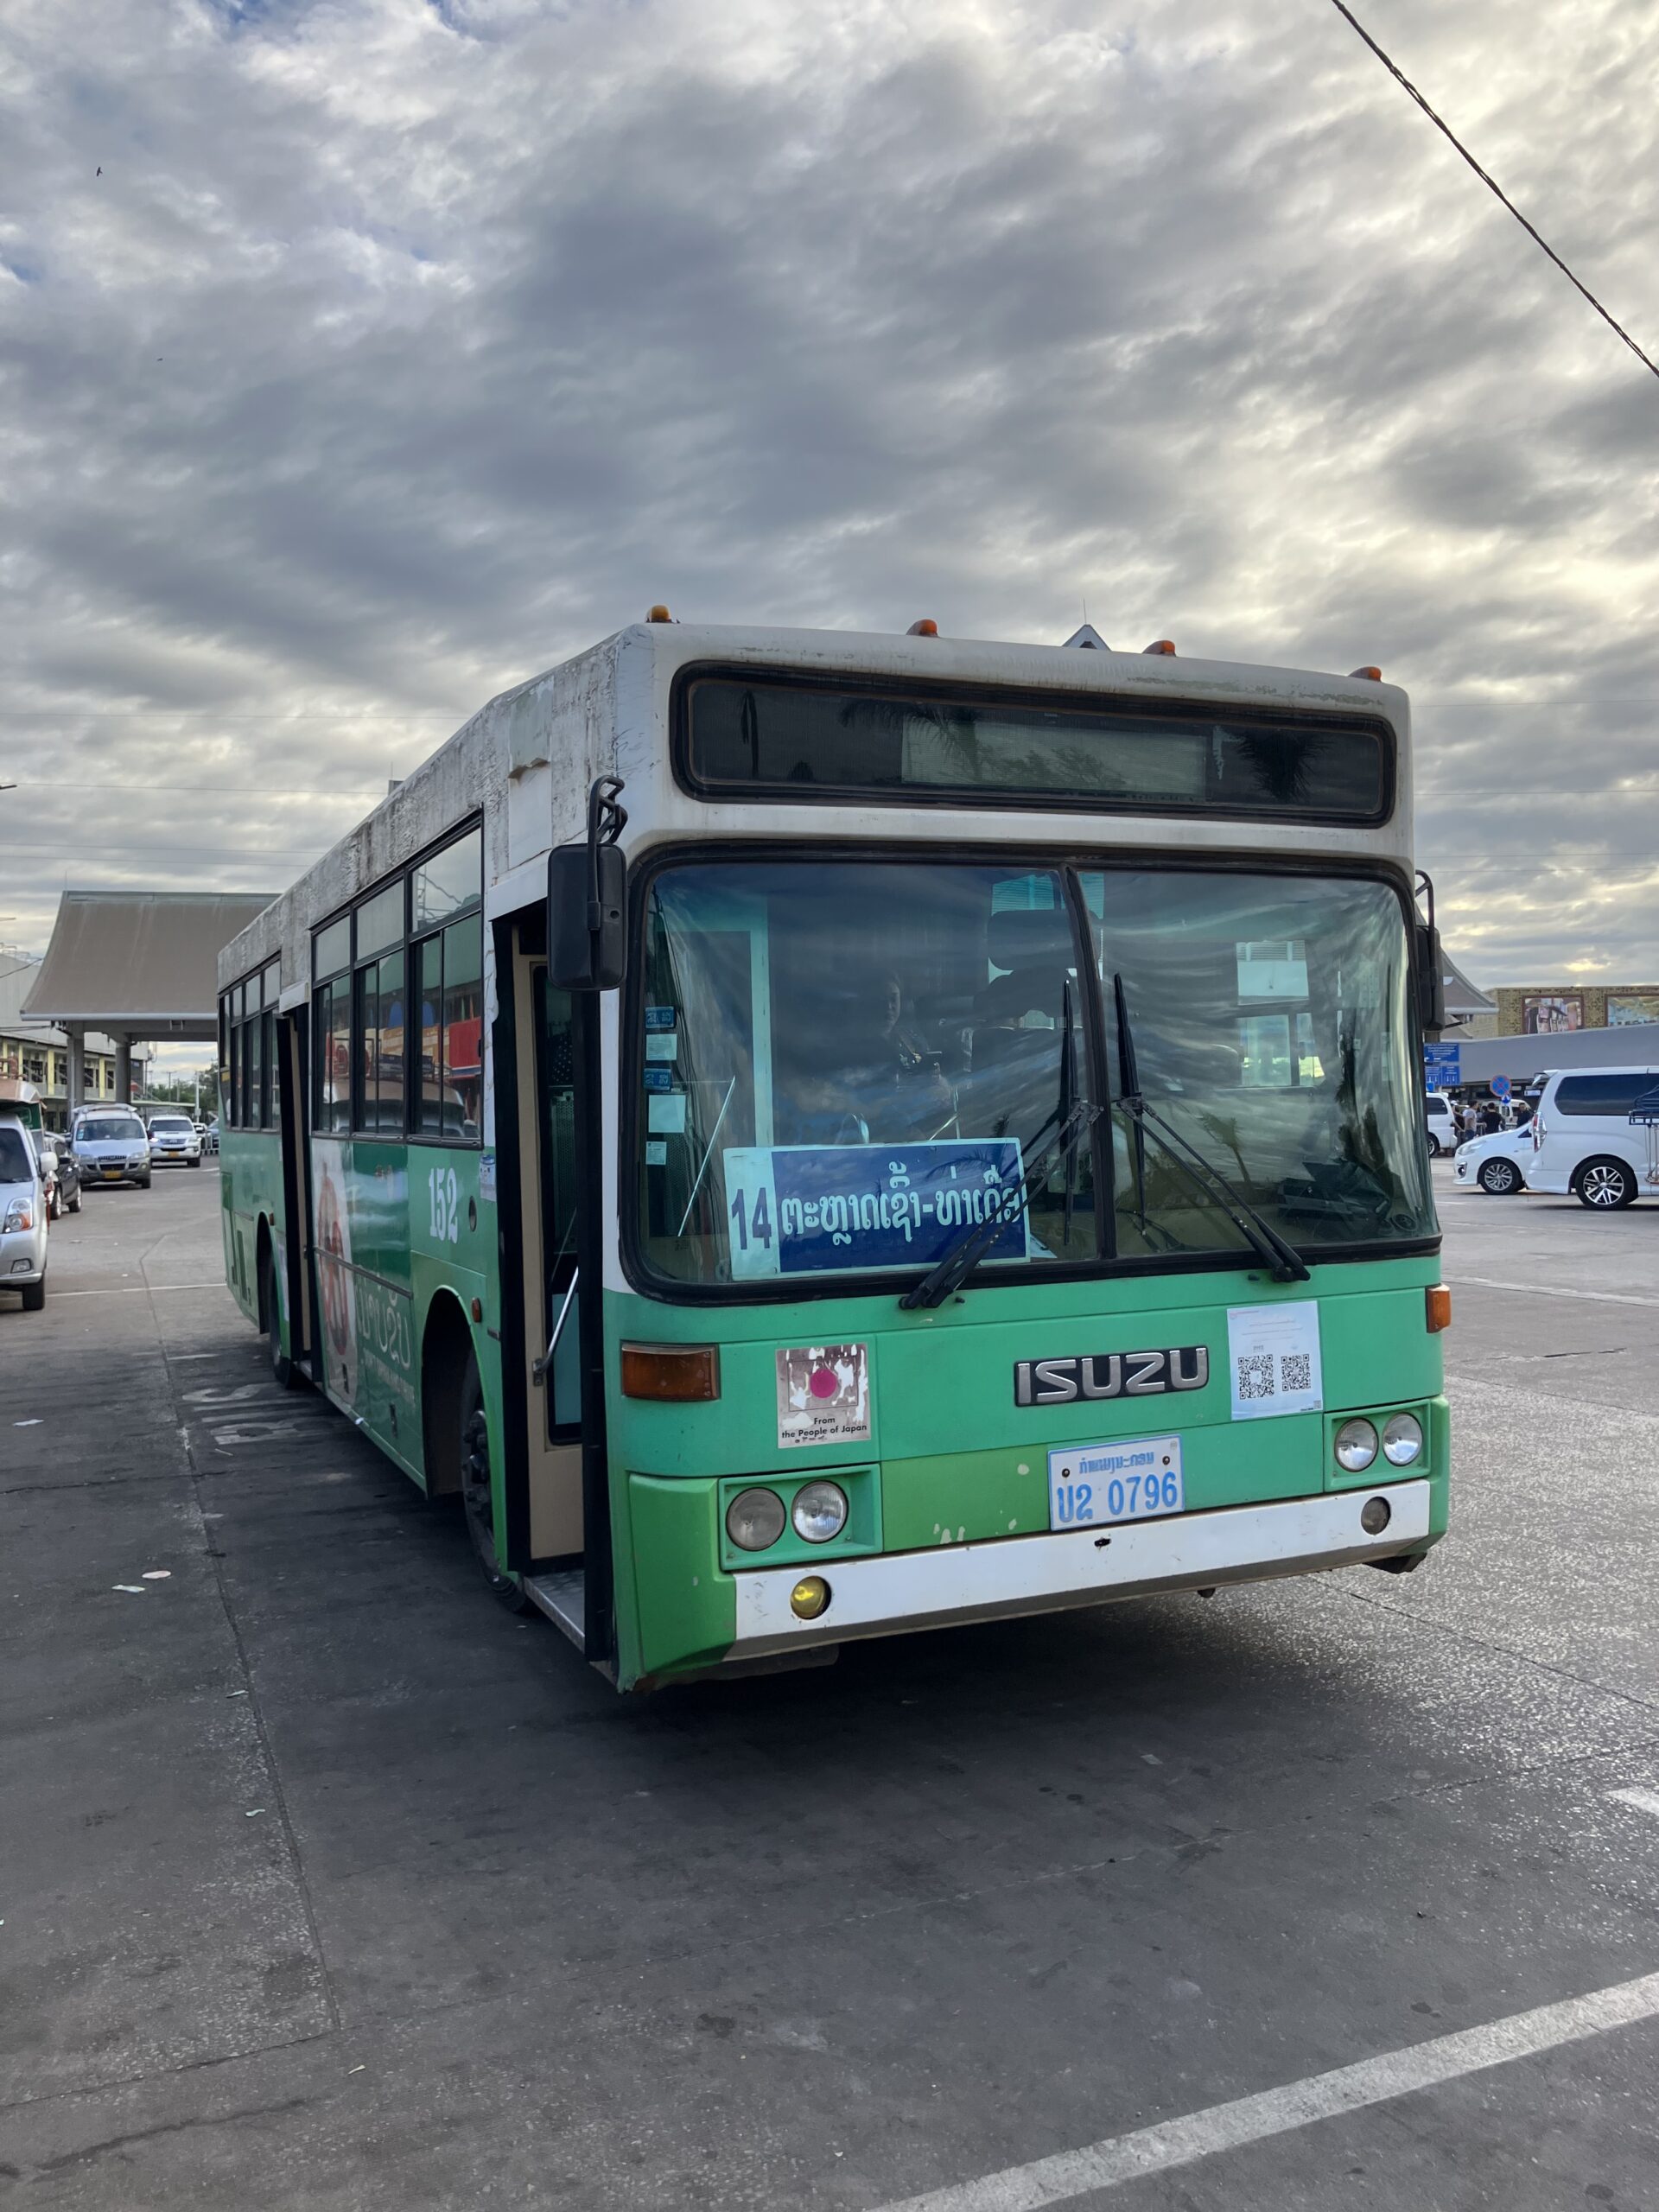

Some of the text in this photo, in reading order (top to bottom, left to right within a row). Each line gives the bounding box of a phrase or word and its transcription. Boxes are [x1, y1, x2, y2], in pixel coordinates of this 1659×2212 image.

[429, 1166, 458, 1244] 152
[732, 1187, 772, 1250] 14
[1017, 1346, 1208, 1404] ISUZU
[798, 1427, 828, 1437] People
[842, 1425, 868, 1433] Japan
[1107, 1471, 1179, 1516] 0796
